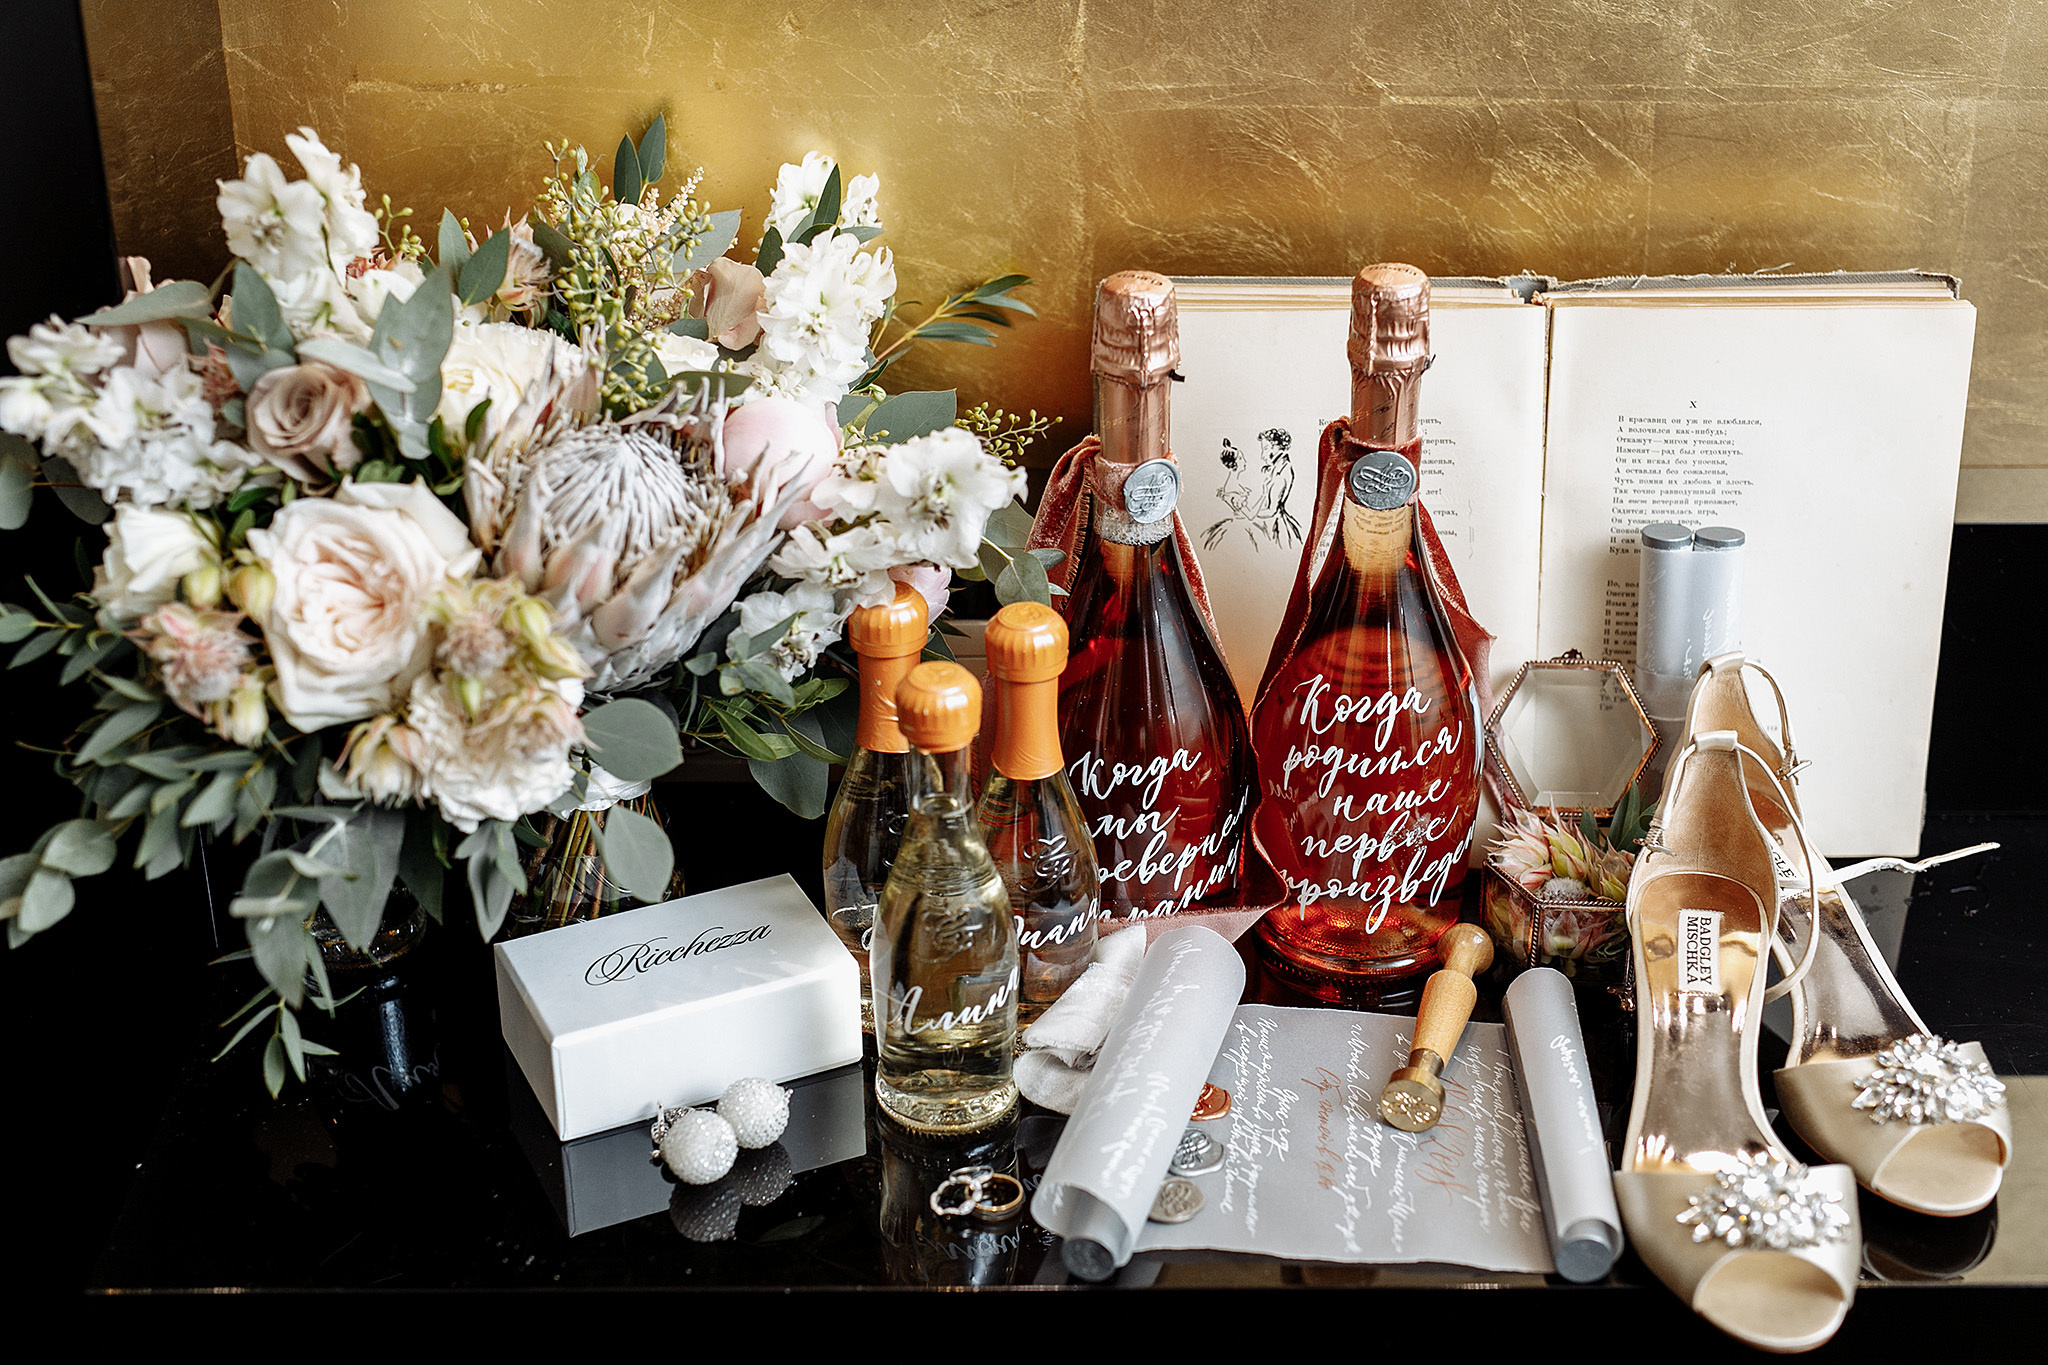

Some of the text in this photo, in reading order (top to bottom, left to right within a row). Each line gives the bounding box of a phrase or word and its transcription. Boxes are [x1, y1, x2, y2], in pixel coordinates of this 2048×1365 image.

[1628, 416, 1667, 425] красавиц
[1293, 673, 1431, 751] Когда
[1069, 747, 1202, 811] Когда
[1283, 720, 1462, 798] родится
[1092, 804, 1181, 840] мы
[1333, 778, 1450, 821] наше
[584, 922, 772, 986] Ricchezza
[1687, 916, 1698, 985] MISCHKA
[1700, 916, 1712, 986] BADGLEY
